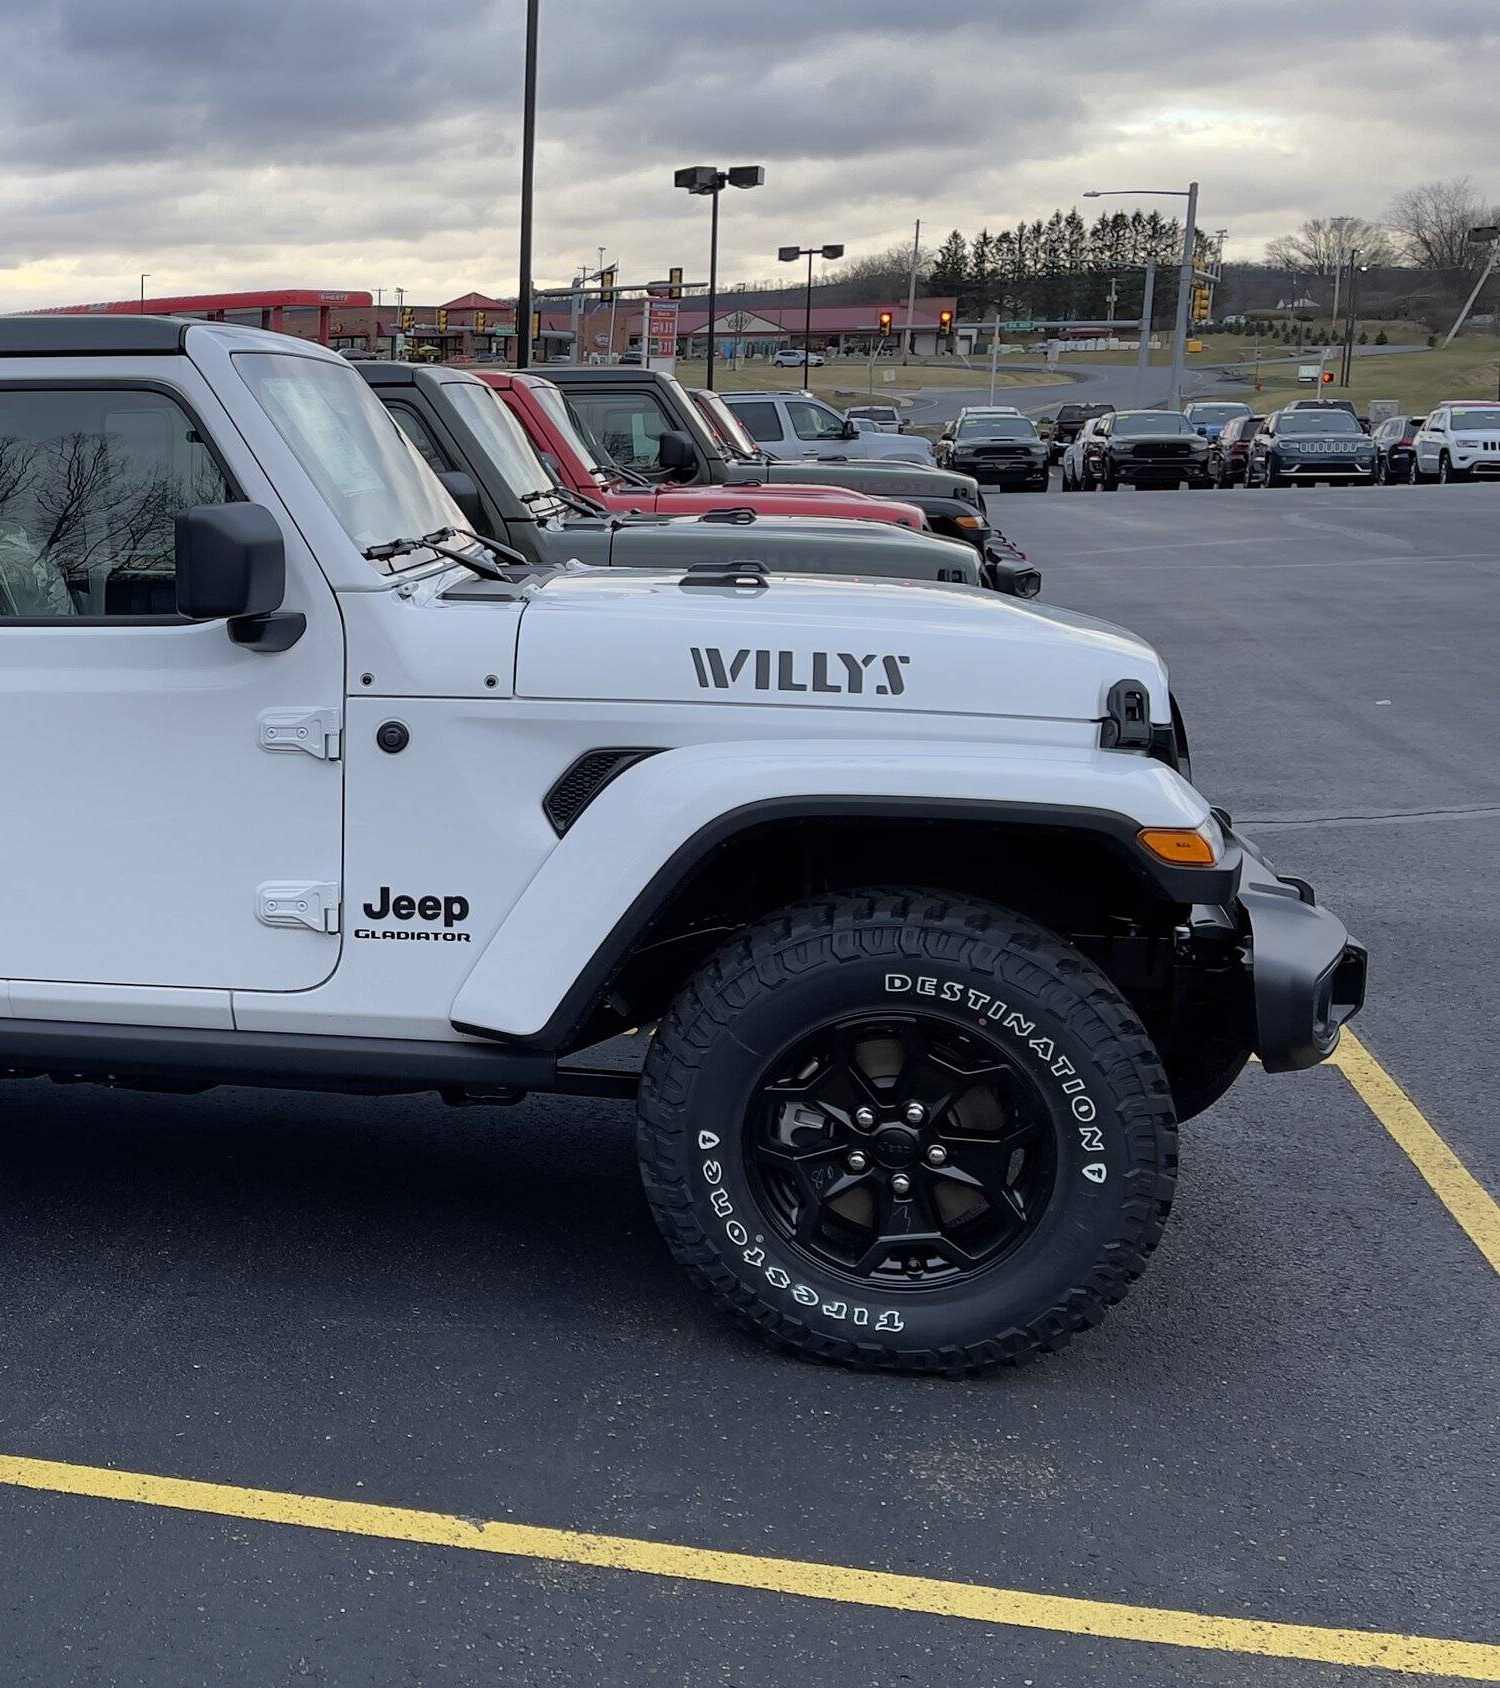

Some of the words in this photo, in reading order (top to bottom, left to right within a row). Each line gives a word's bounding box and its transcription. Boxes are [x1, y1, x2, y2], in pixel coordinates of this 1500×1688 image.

[689, 647, 911, 696] WILLYS
[363, 886, 470, 927] Jeep
[354, 929, 471, 942] GLADIATOR
[884, 973, 1106, 1152] DESTINATION
